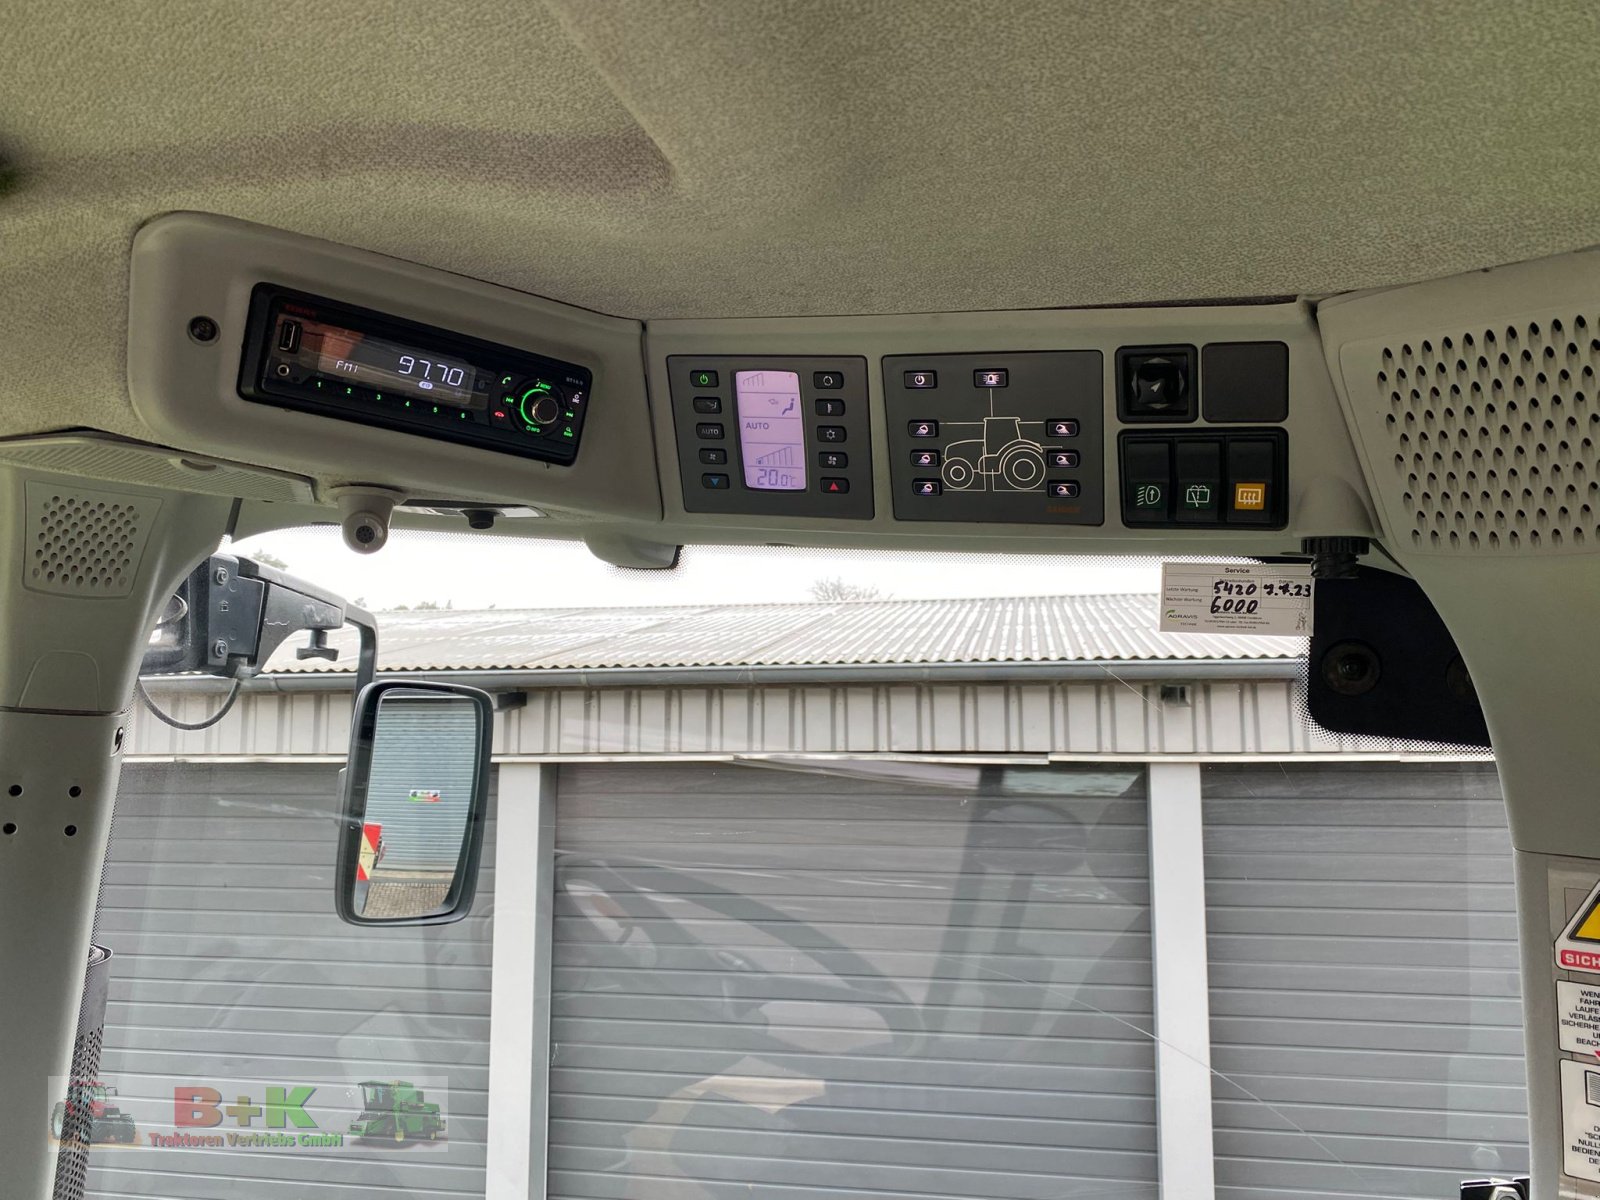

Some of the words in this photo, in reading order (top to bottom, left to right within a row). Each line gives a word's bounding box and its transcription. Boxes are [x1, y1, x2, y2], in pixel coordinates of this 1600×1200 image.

[398, 355, 464, 386] 97.70
[745, 422, 770, 430] AUTO
[1213, 580, 1258, 596] 5420
[1210, 595, 1259, 614] 6000
